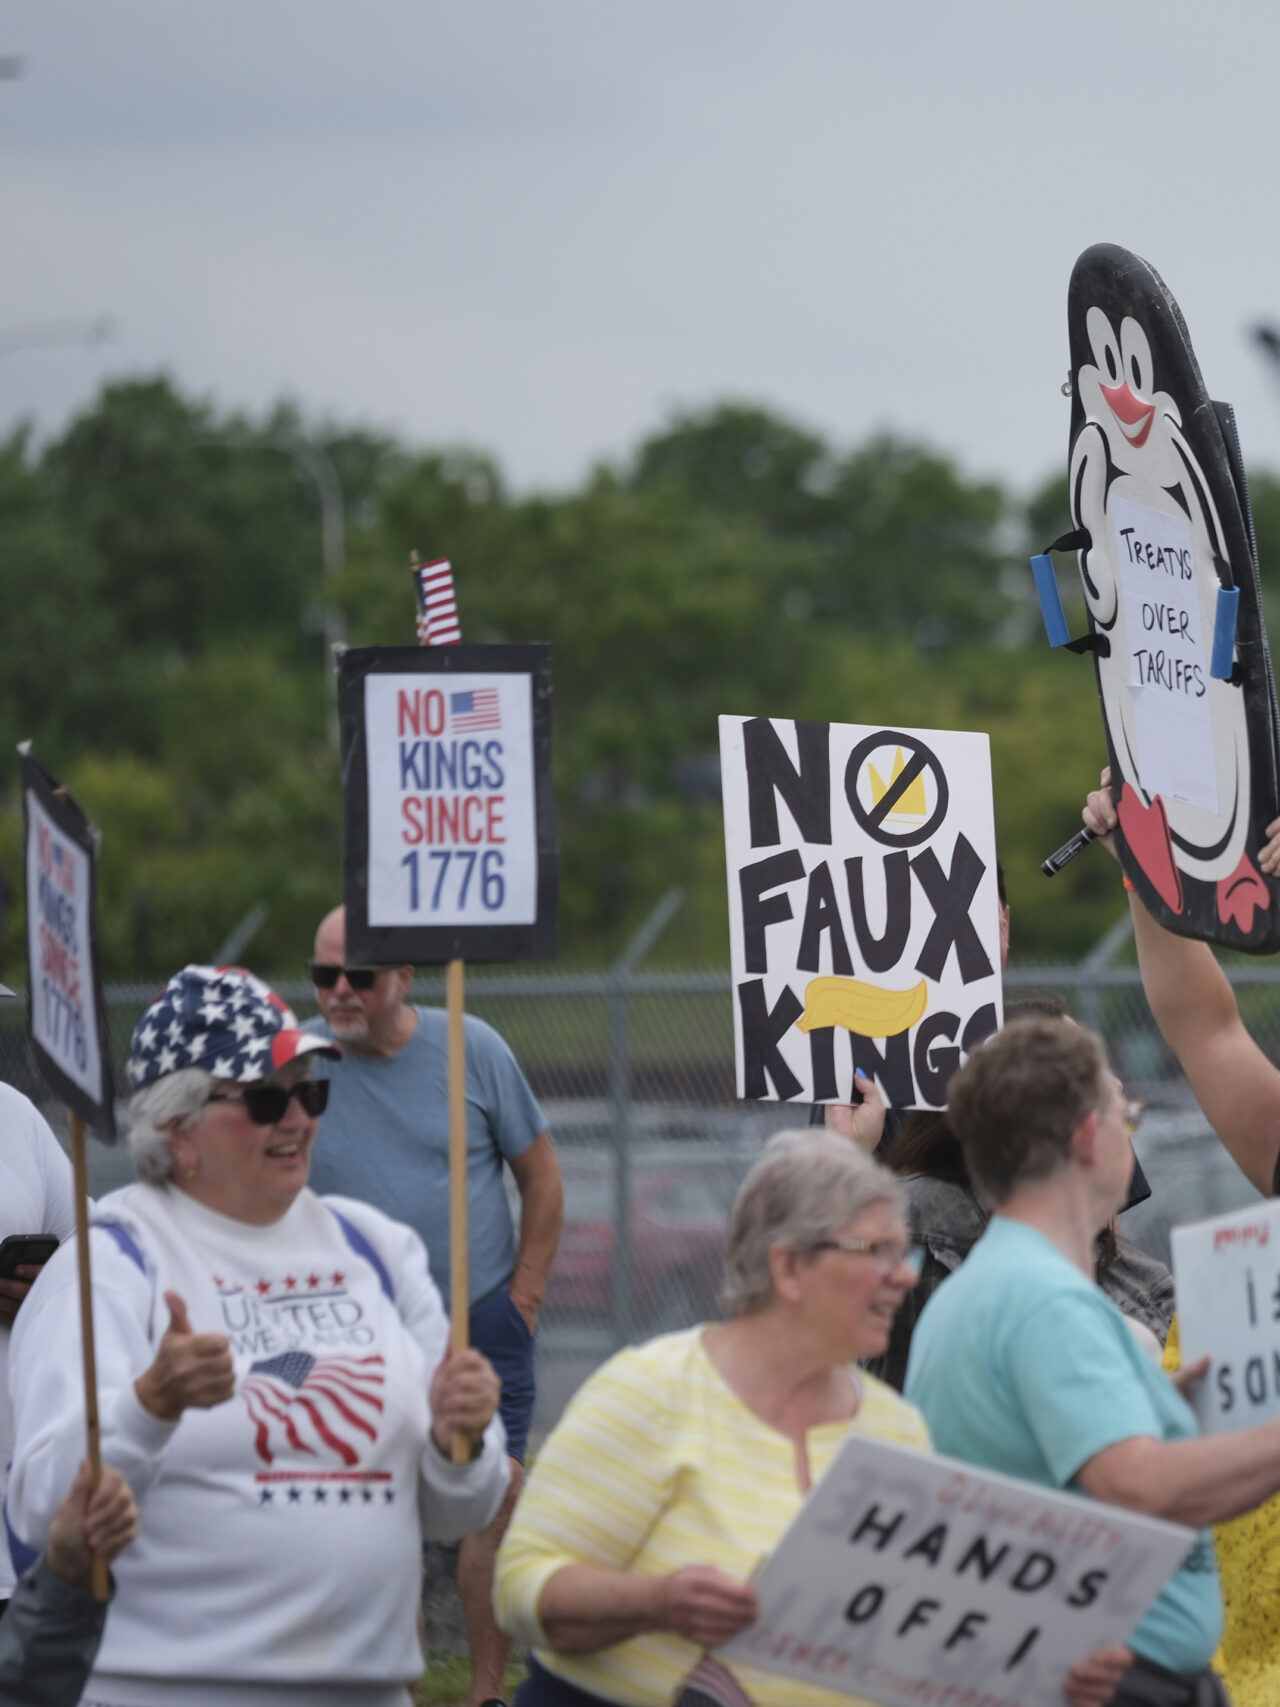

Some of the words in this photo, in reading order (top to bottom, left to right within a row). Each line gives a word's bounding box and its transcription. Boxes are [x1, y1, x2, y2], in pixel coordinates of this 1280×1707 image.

[1119, 527, 1194, 581] TREATYS
[1142, 603, 1195, 645] OVER
[1133, 649, 1206, 698] TARIFFS
[397, 688, 447, 738] NO
[399, 739, 506, 791] KINGS
[401, 795, 507, 846] SINCE
[401, 848, 506, 913] 1776
[739, 831, 995, 986] FAUX
[848, 1502, 1110, 1610] HANDS
